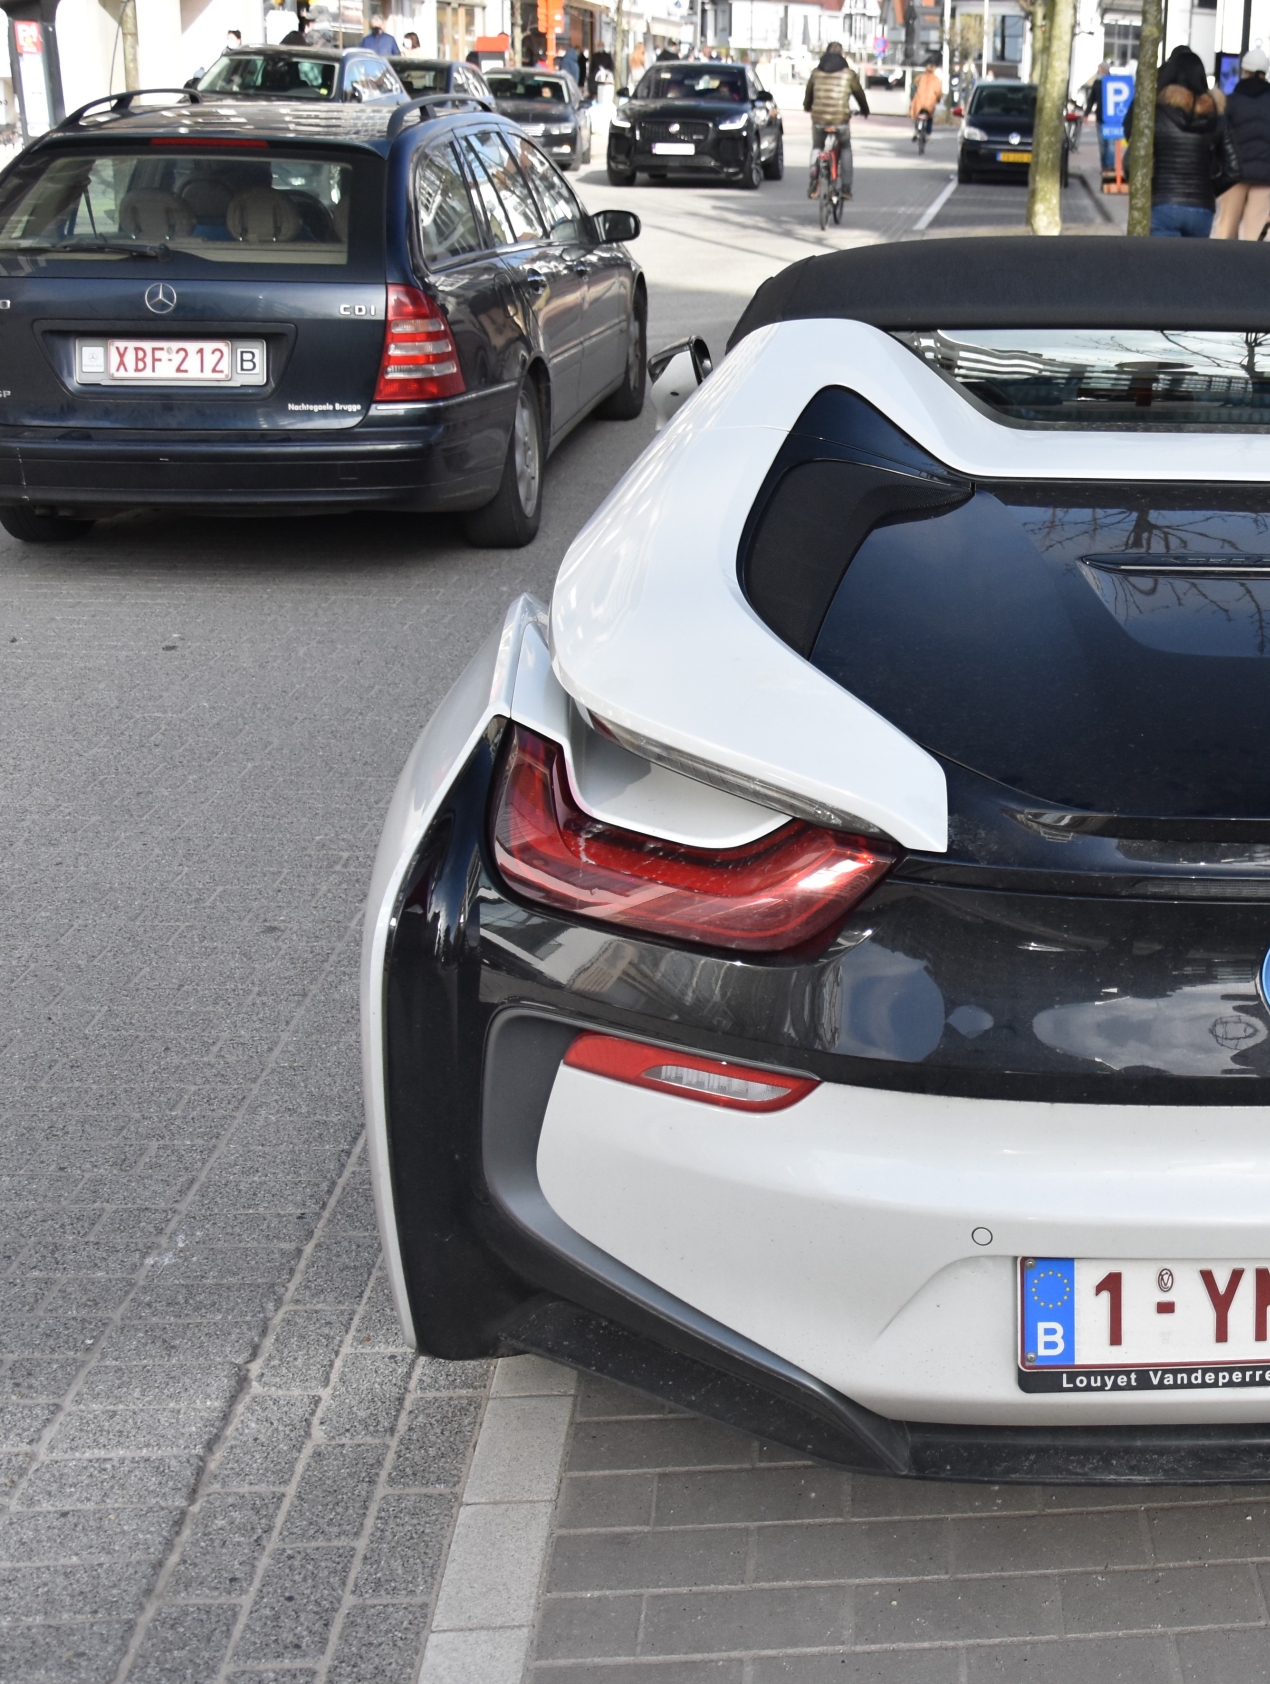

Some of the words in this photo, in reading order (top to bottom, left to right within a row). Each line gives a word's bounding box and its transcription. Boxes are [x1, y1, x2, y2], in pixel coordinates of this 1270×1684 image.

[1106, 81, 1130, 117] P
[339, 304, 376, 316] CDI
[115, 346, 225, 374] XBF-212
[239, 350, 257, 372] B
[335, 403, 362, 412] Brugge
[1036, 1322, 1065, 1357] B
[1062, 1372, 1138, 1390] Louyet
